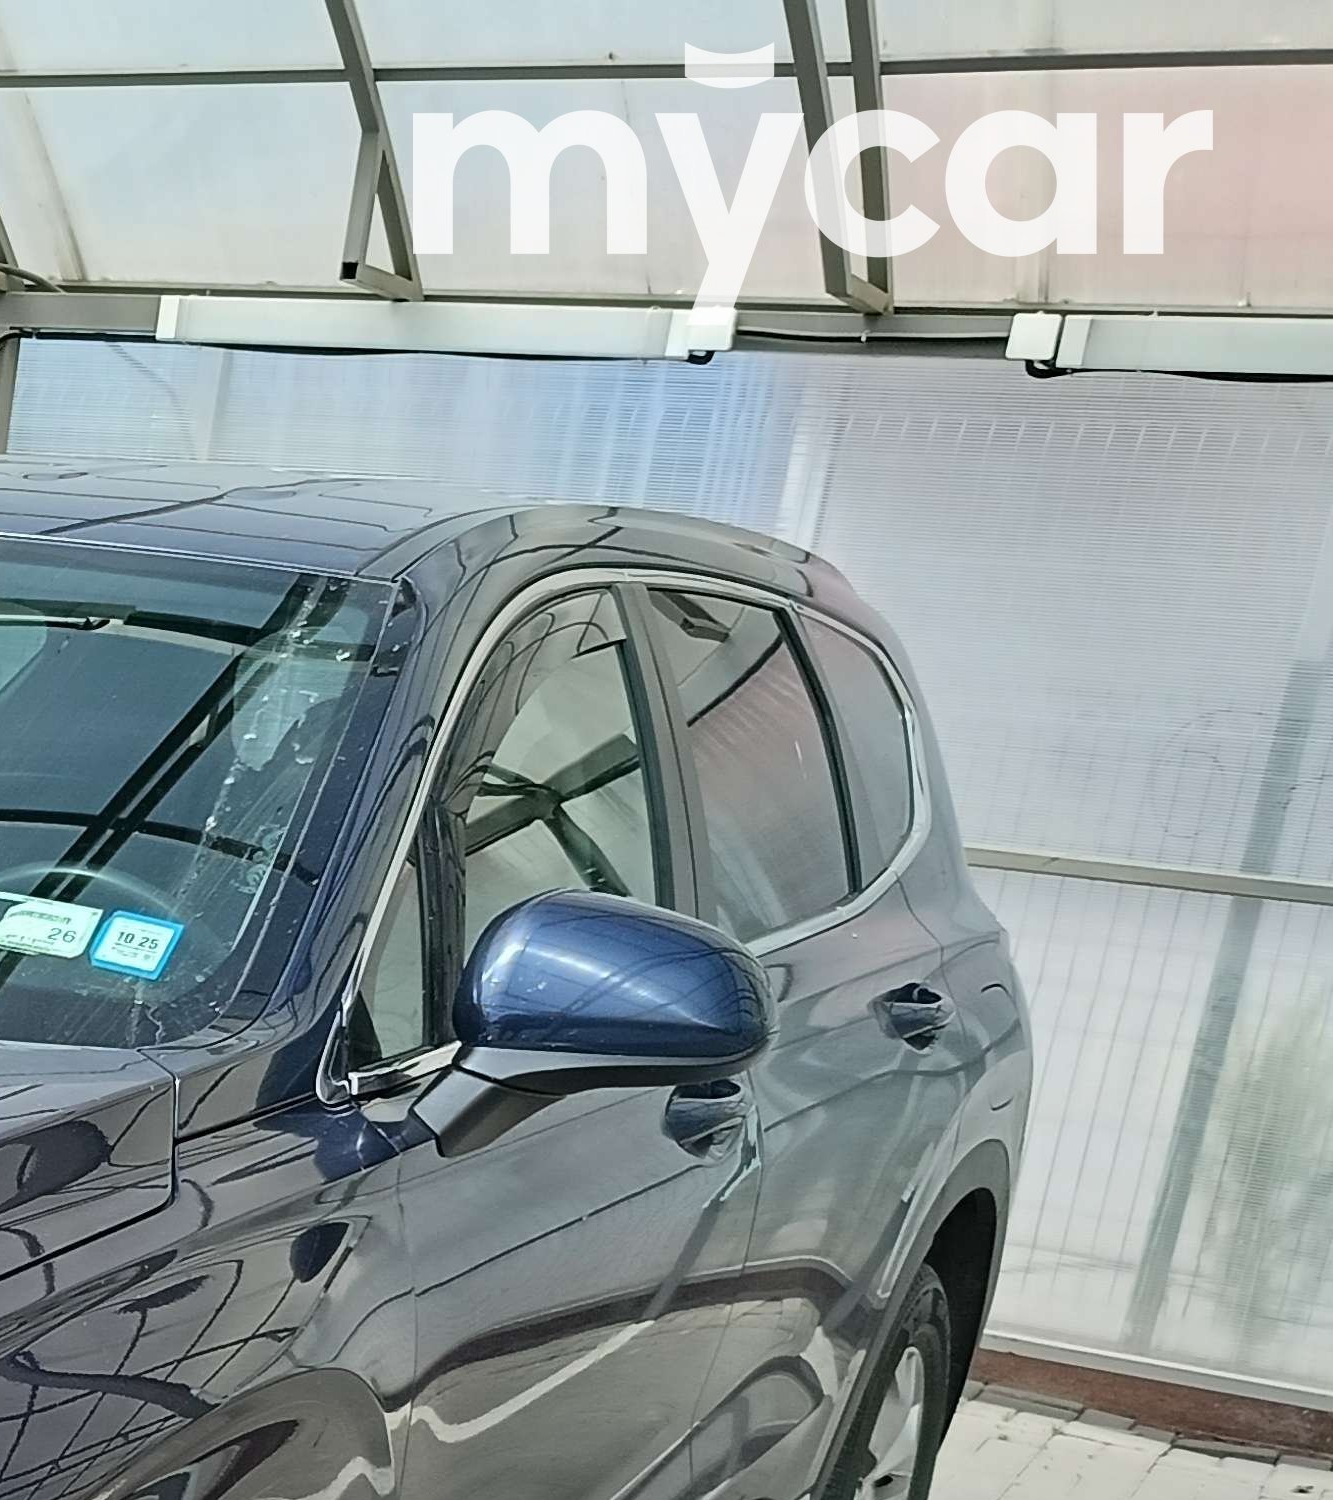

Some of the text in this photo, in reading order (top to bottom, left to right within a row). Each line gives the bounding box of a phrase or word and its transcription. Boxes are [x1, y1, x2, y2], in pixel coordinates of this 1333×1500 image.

[46, 927, 77, 944] 26
[117, 931, 160, 950] 10 25
